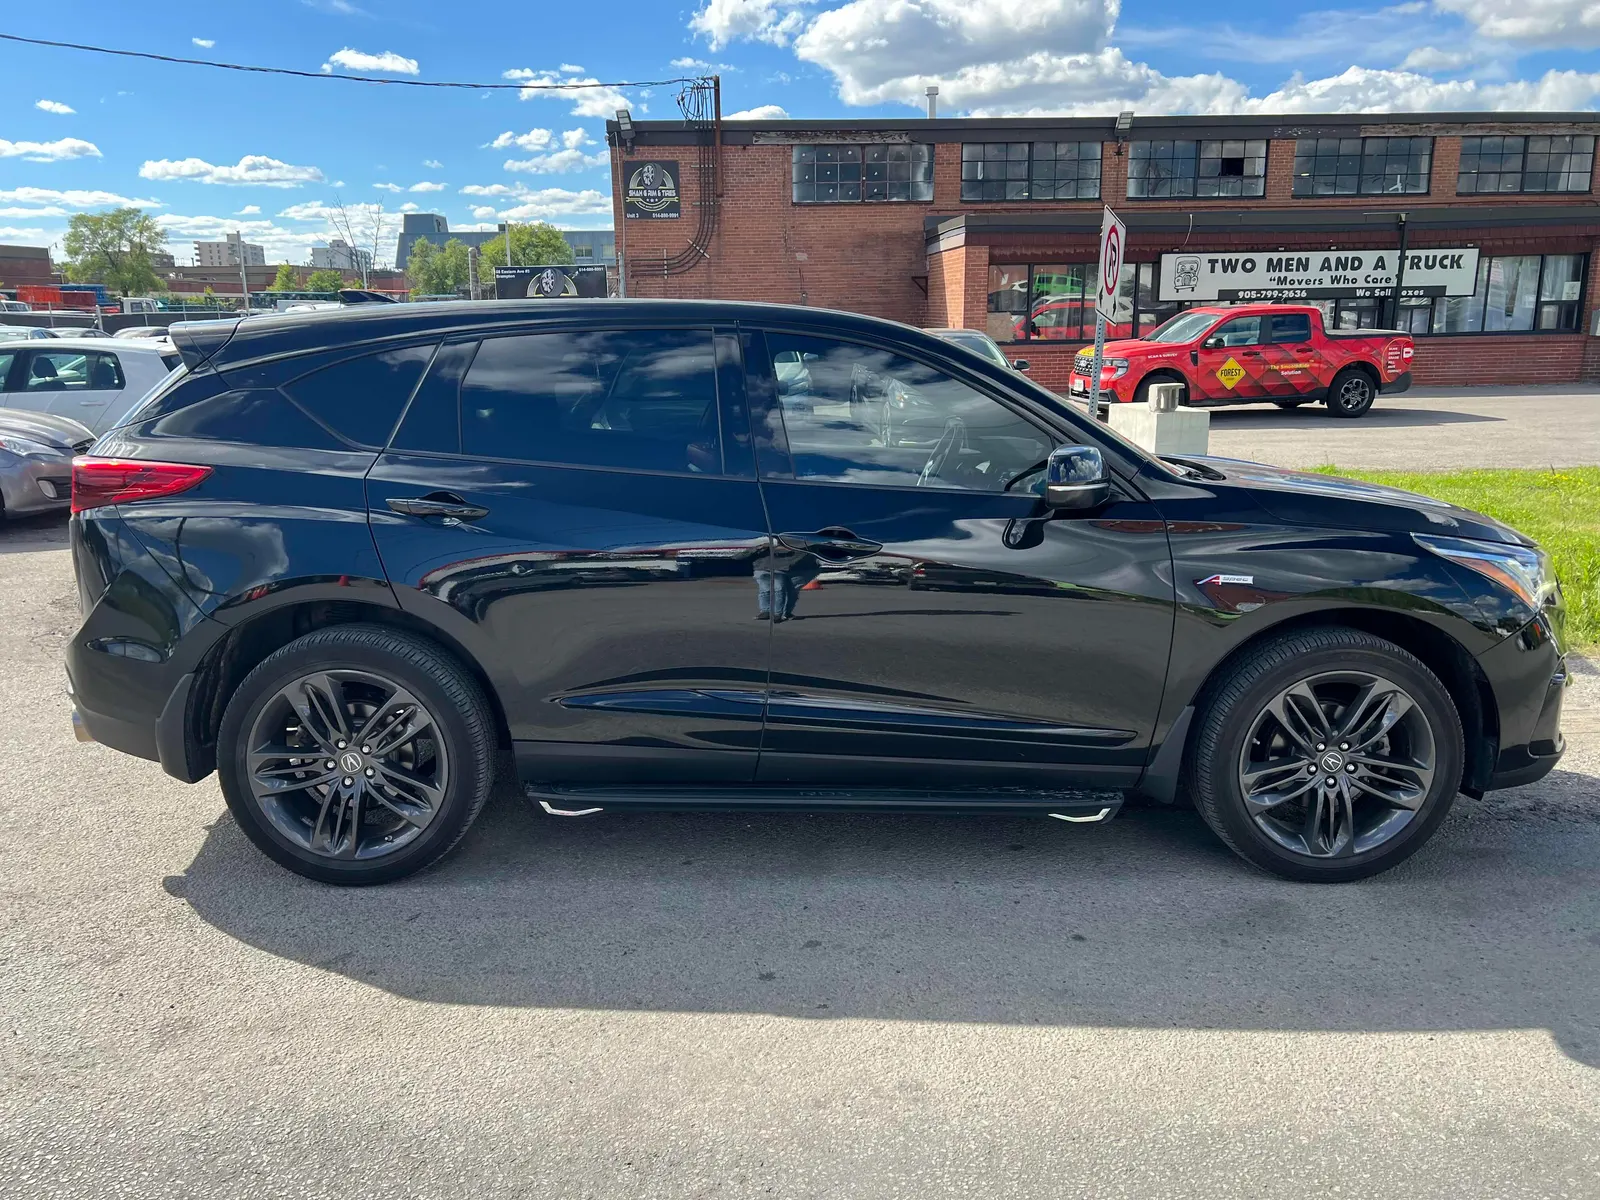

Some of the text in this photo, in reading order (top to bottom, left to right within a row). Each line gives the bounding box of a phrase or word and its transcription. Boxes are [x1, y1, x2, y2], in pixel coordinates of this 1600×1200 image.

[1207, 258, 1257, 274] TWO
[1266, 256, 1310, 273] MEN
[1319, 256, 1363, 272] AND
[1372, 256, 1386, 271] A
[1330, 274, 1358, 285] Who
[1238, 290, 1307, 299] 905-799-2636
[1356, 288, 1370, 297] We
[1374, 288, 1392, 296] Sell
[1220, 368, 1241, 377] FOREST
